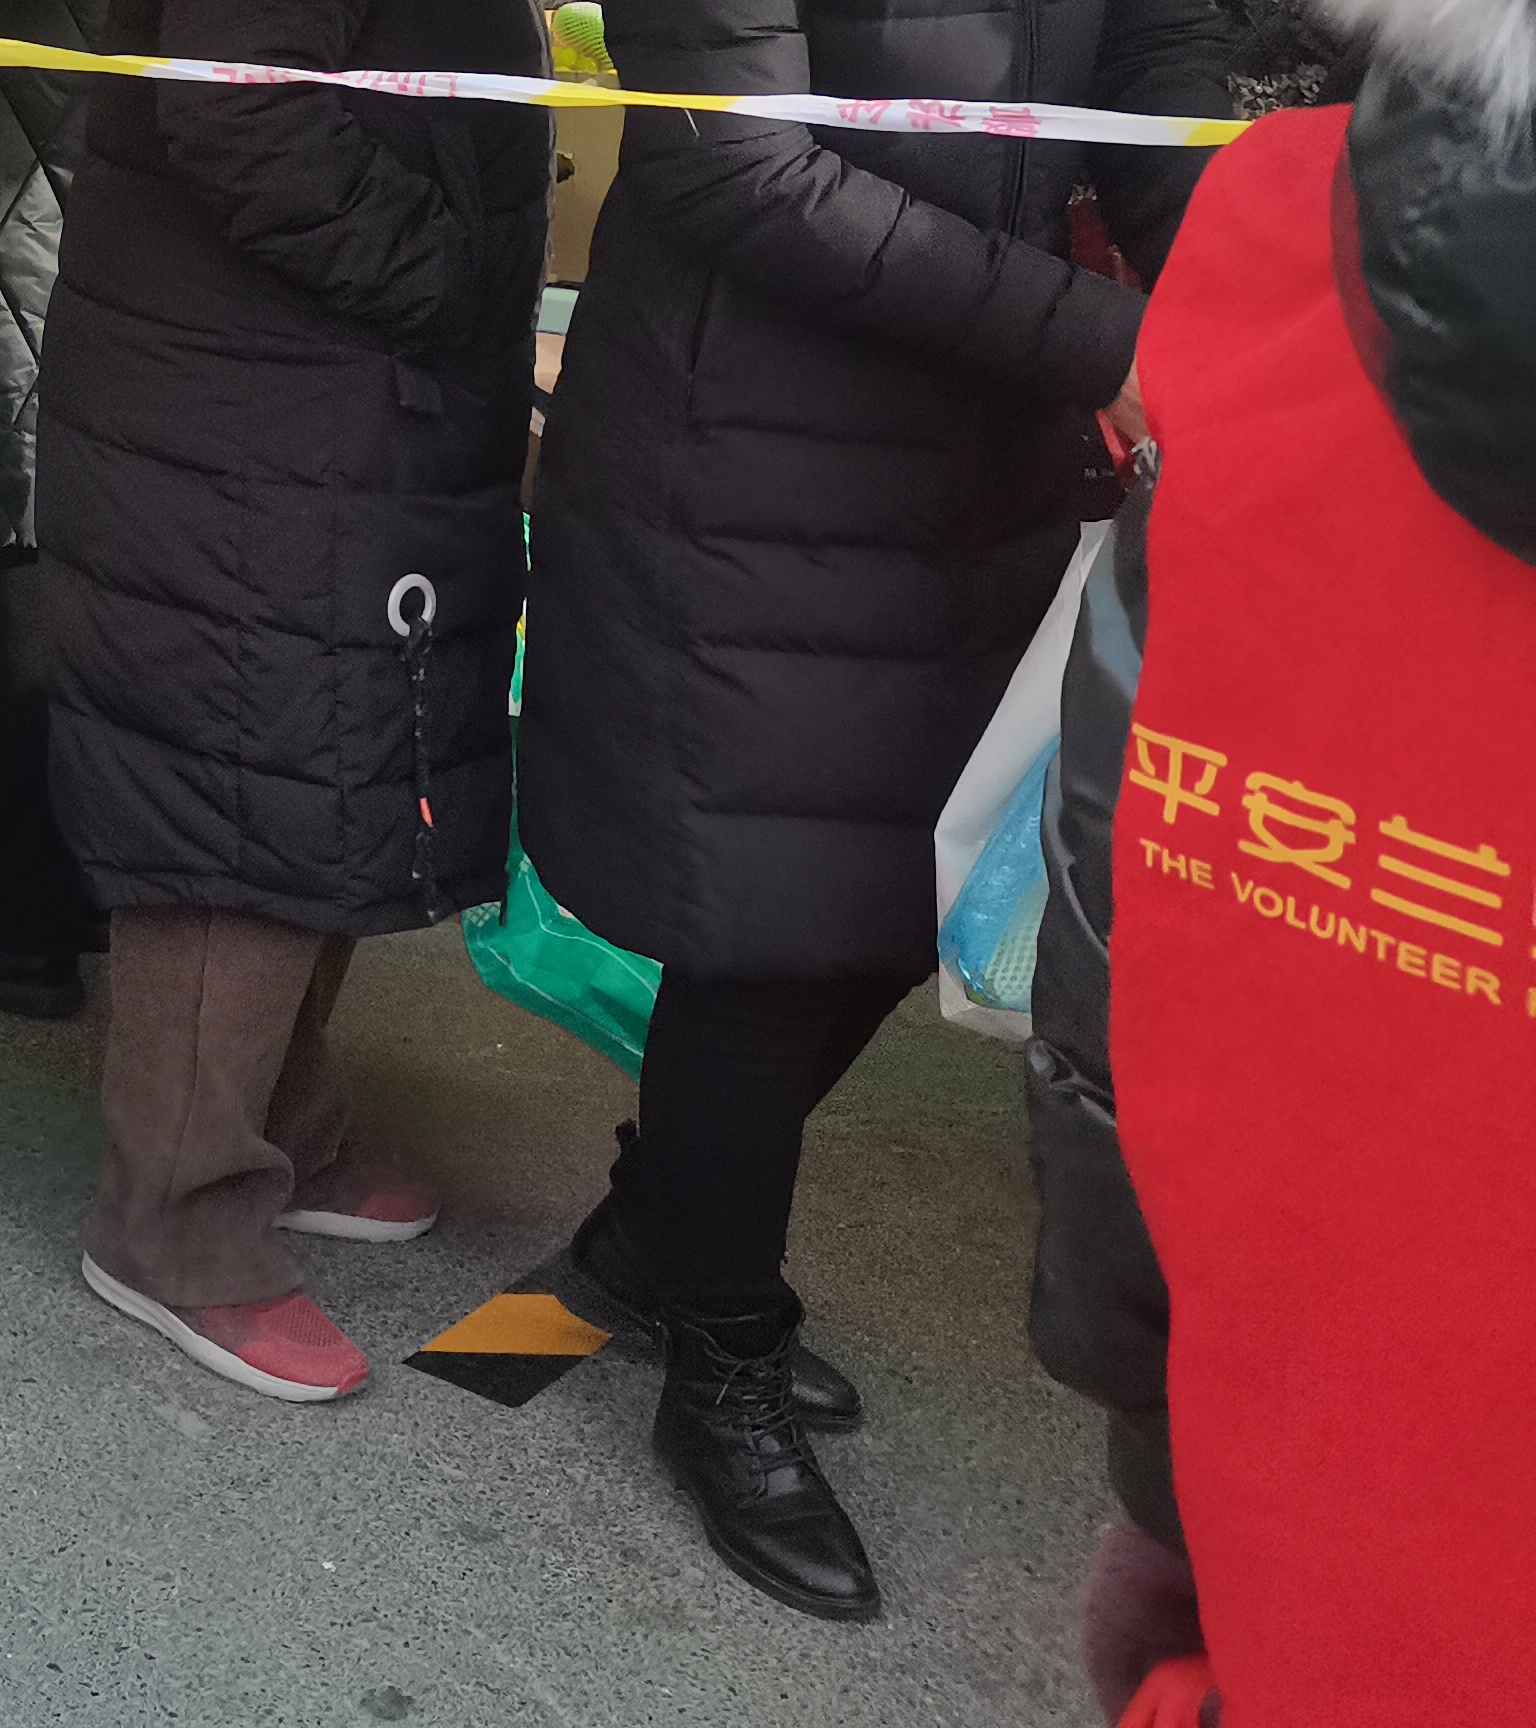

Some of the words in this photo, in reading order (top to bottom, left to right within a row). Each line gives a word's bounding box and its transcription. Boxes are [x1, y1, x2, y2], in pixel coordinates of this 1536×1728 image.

[1129, 723, 1536, 946] 平安兰
[1140, 838, 1215, 890] THE
[1231, 872, 1502, 1005] VOLUNTEER
